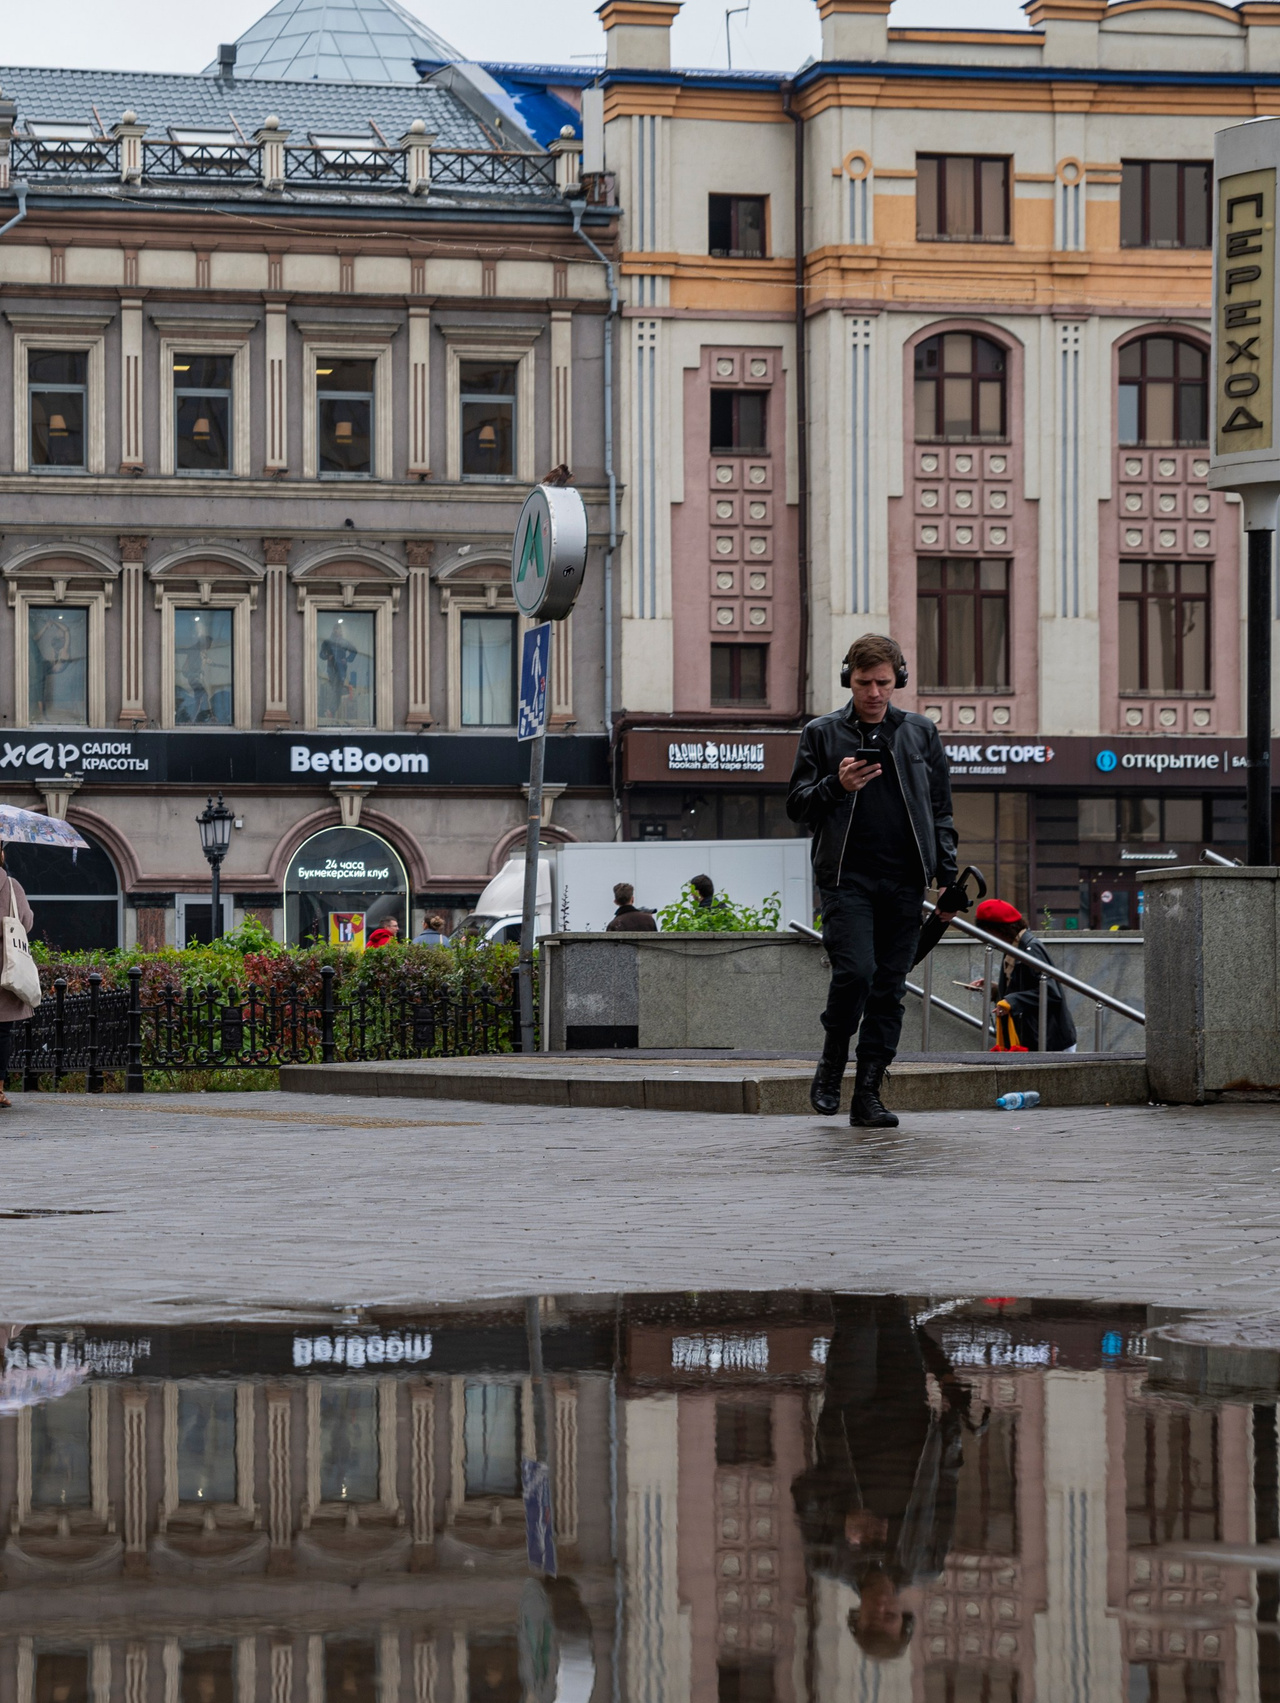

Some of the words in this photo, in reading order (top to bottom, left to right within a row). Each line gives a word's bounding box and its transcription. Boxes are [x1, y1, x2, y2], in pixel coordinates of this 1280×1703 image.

[1222, 192, 1263, 433] ПЕРЕХОД
[82, 743, 131, 755] САЛОН
[945, 745, 982, 762] ЧАК
[985, 745, 1045, 763] СТОРЕ
[82, 758, 149, 771] КРАСОТЫ
[290, 746, 429, 773] BetBoom
[668, 761, 701, 769] hookah
[702, 761, 719, 769] and
[720, 763, 741, 771] vape
[742, 762, 764, 771] shop
[1121, 753, 1220, 773] открытие
[1232, 756, 1248, 767] БА
[325, 859, 337, 869] 24
[340, 861, 365, 870] часа
[298, 868, 366, 879] Букмекерский
[367, 868, 389, 879] клуб
